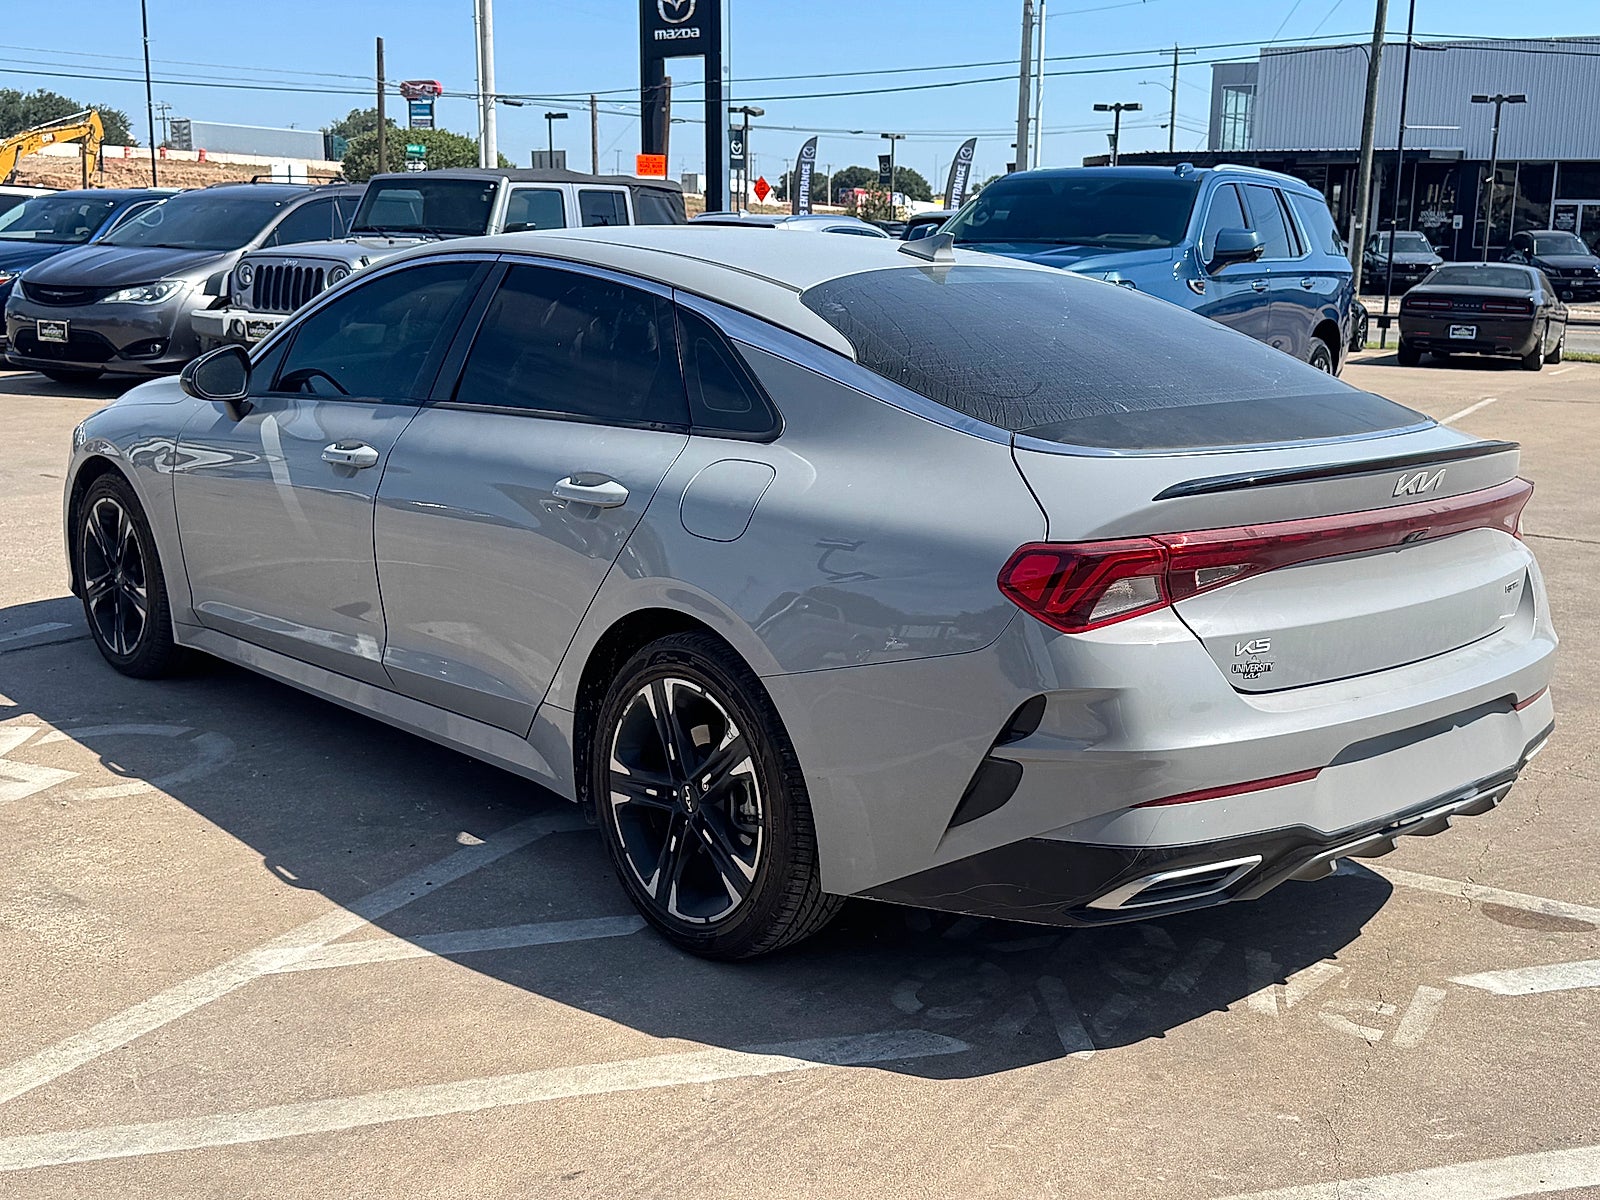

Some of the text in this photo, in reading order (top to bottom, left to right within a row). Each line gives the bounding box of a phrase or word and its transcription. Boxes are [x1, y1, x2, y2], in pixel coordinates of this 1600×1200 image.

[654, 27, 701, 41] mazda
[799, 163, 811, 208] ENTRANCE
[1234, 637, 1271, 657] K5
[1231, 661, 1275, 673] UNIVERSITY
